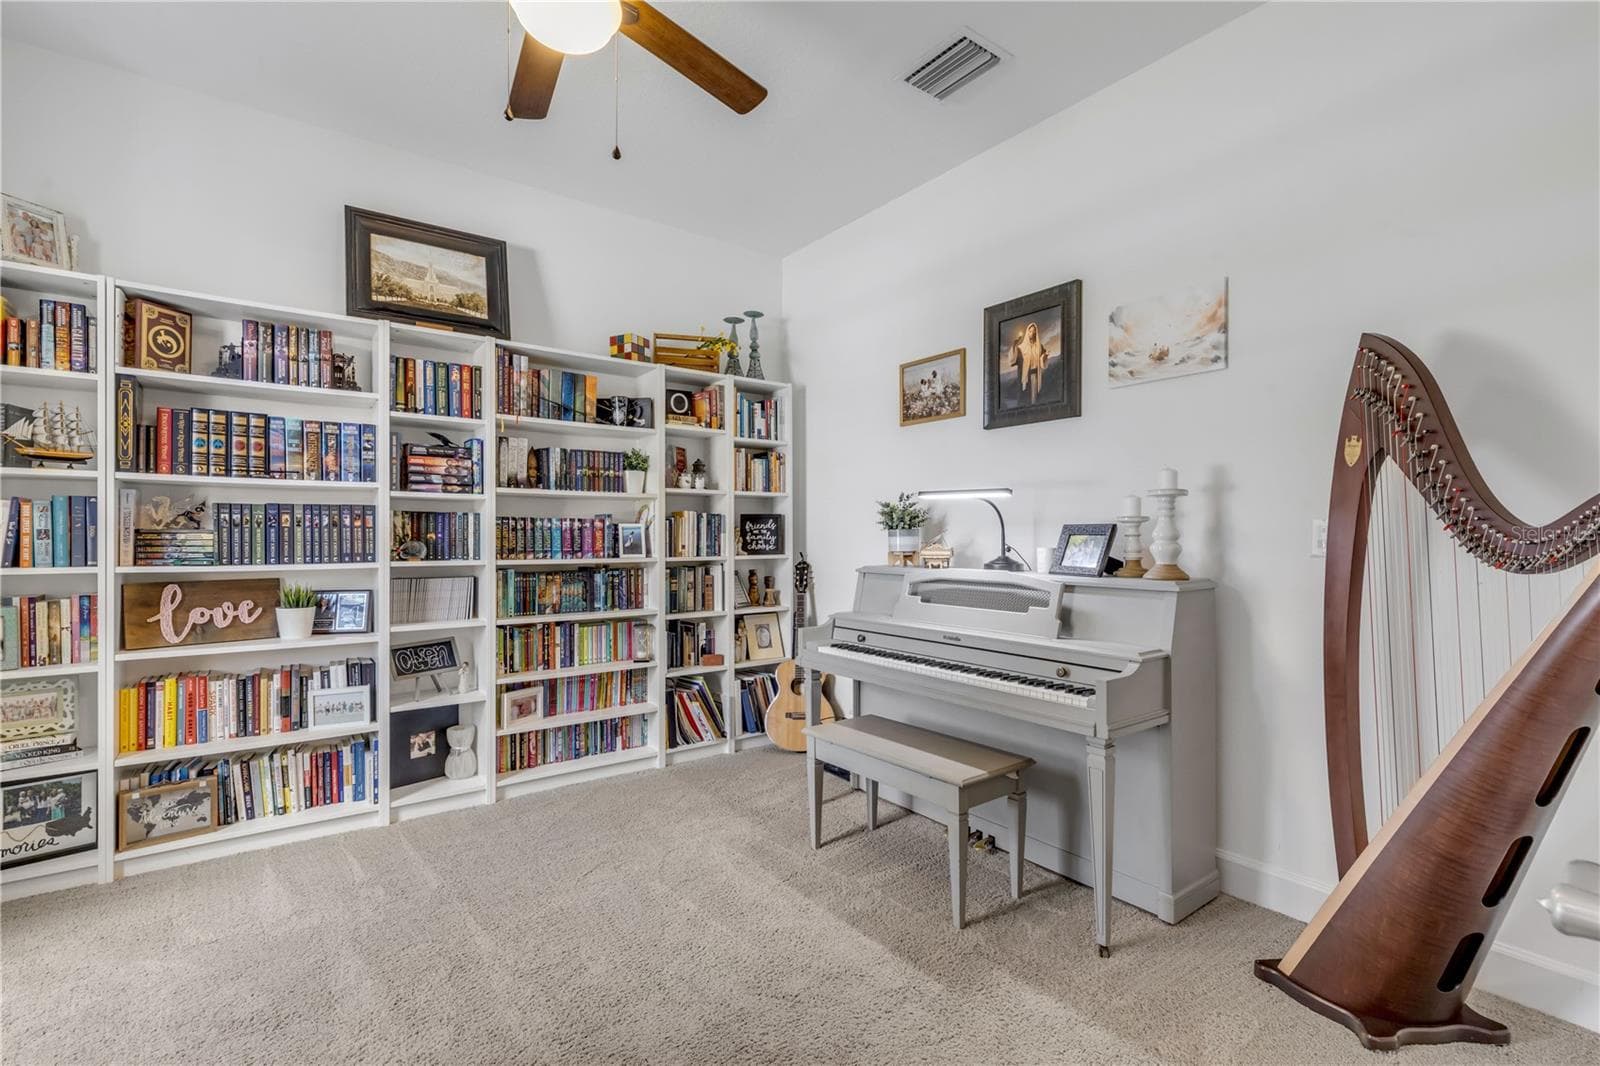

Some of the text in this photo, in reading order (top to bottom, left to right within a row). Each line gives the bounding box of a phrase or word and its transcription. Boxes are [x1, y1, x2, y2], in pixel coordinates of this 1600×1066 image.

[746, 531, 776, 544] family
[146, 583, 262, 643] love
[395, 645, 451, 673] Olsen
